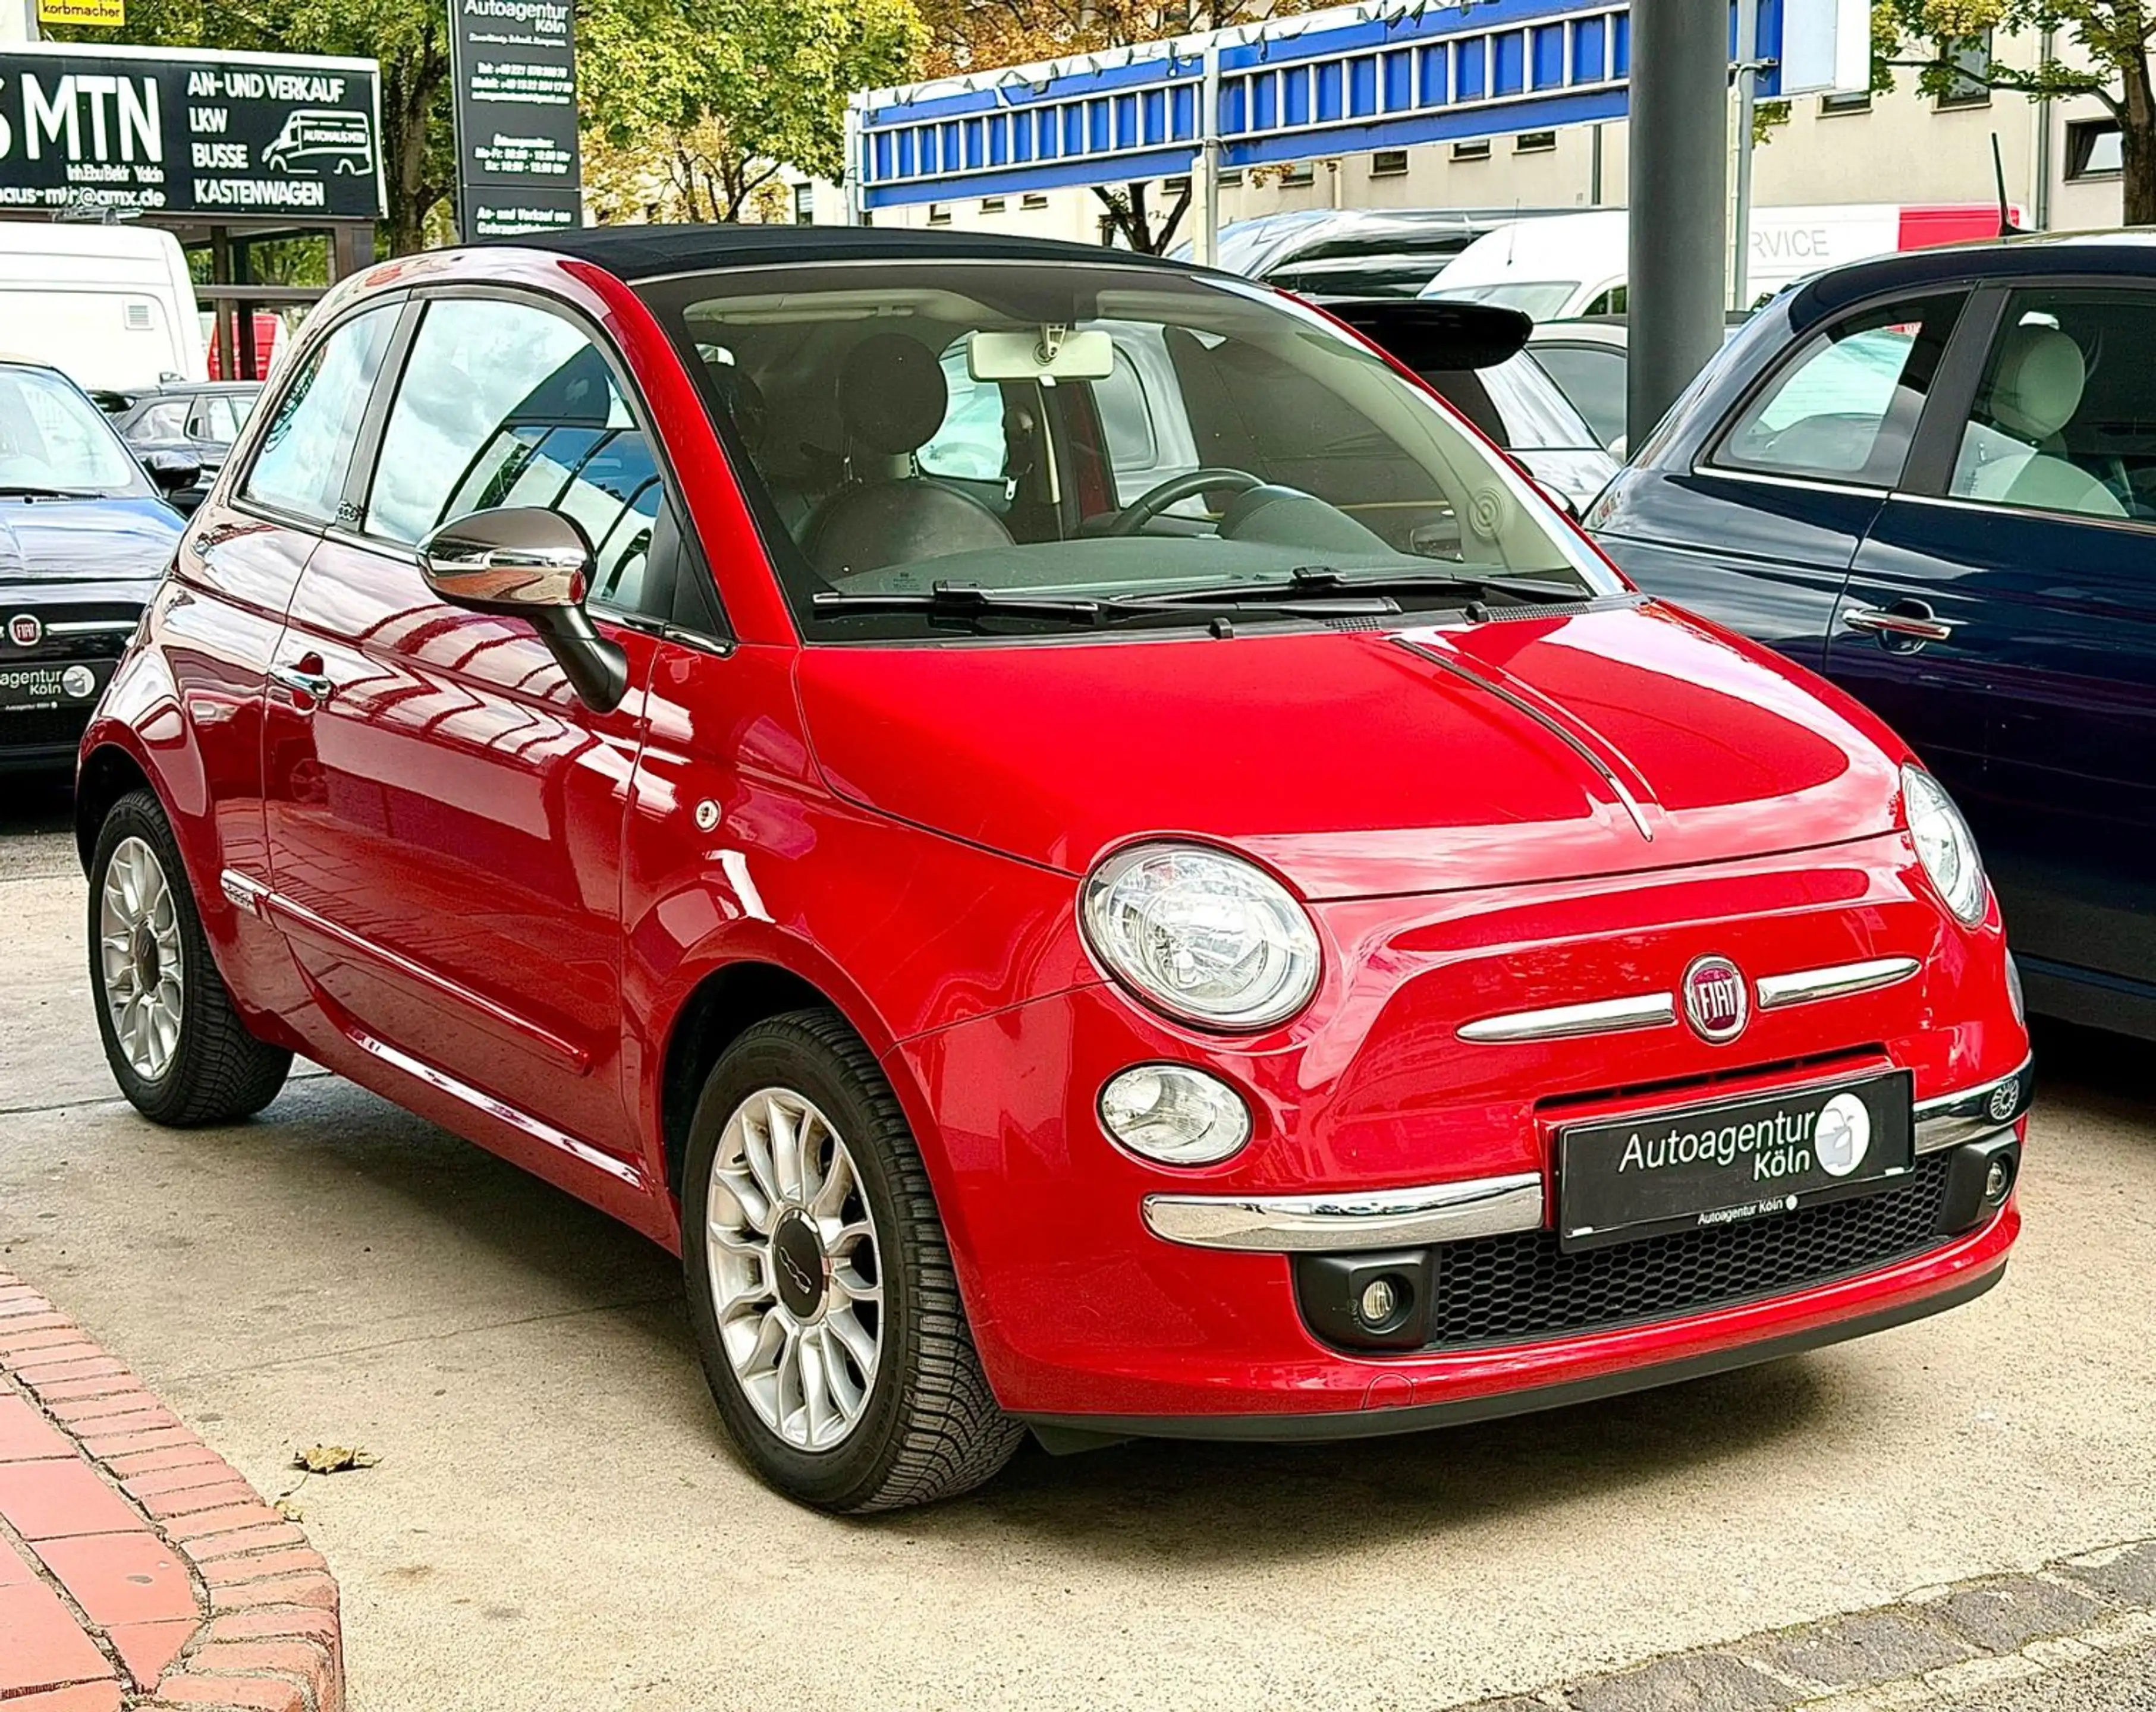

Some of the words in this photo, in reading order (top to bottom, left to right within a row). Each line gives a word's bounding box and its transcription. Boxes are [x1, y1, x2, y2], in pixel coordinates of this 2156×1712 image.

[464, 0, 569, 21] Autoagentur
[265, 74, 345, 103] VERKAUF
[21, 73, 163, 162] MTN
[188, 107, 228, 133] LKW
[191, 143, 249, 169] BUSSE
[194, 179, 325, 206] KASTENWAGEN
[1698, 979, 1736, 1019] FIAT
[1618, 1110, 1816, 1173] Autoagentur
[1753, 1145, 1811, 1181] Köln
[1698, 1205, 1757, 1226] Autoagentur
[1759, 1198, 1783, 1214] Köln
